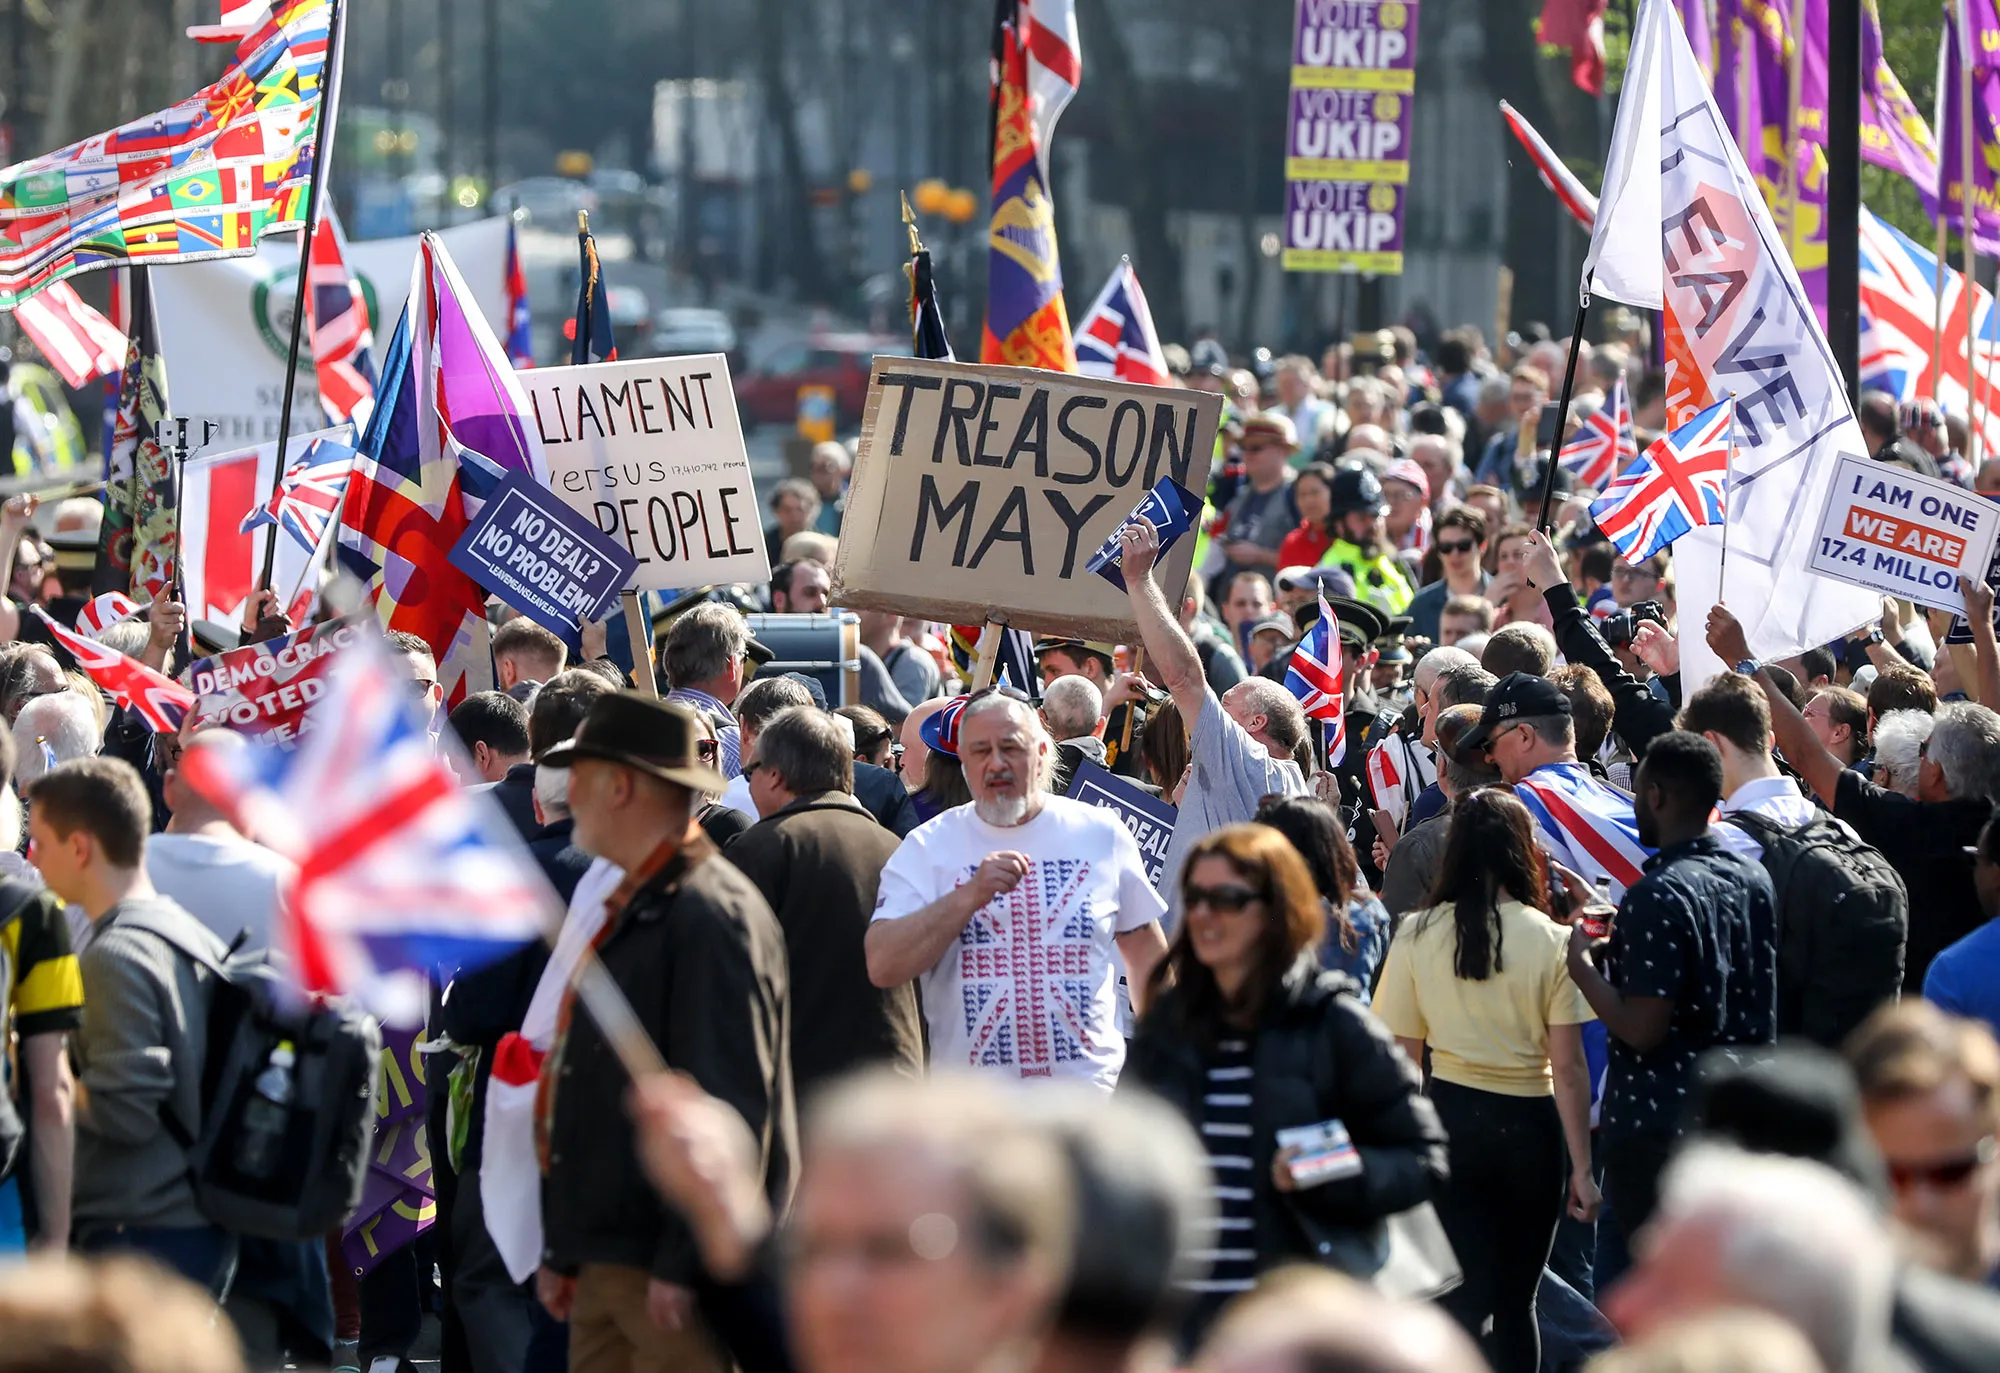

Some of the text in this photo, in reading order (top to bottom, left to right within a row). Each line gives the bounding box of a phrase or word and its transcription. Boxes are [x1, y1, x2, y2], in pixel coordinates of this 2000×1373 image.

[1302, 0, 1378, 28] VOTE
[1301, 27, 1407, 69] UKIP
[1299, 88, 1373, 120] VOTE
[1296, 119, 1401, 159] UKIP
[1293, 180, 1367, 211] VOTE
[1291, 209, 1396, 252] UKIP
[531, 372, 713, 444] LIAMENT
[877, 372, 1198, 490] TREASON
[593, 487, 754, 564] PEOPLE
[909, 474, 1115, 579] MAY
[1852, 475, 1980, 532] I AM ONE
[511, 507, 600, 583] NO DEAL?
[1822, 537, 1866, 566] 17.4
[1850, 511, 1899, 543] WE
[1900, 529, 1962, 563] ARE
[479, 523, 596, 616] NO PROBLEM!
[489, 563, 558, 617] LEAVEMEANSLEAVE.EU
[196, 619, 369, 696] DEMOCRACY
[200, 677, 326, 726] VOTED
[1126, 814, 1171, 862] DEAL
